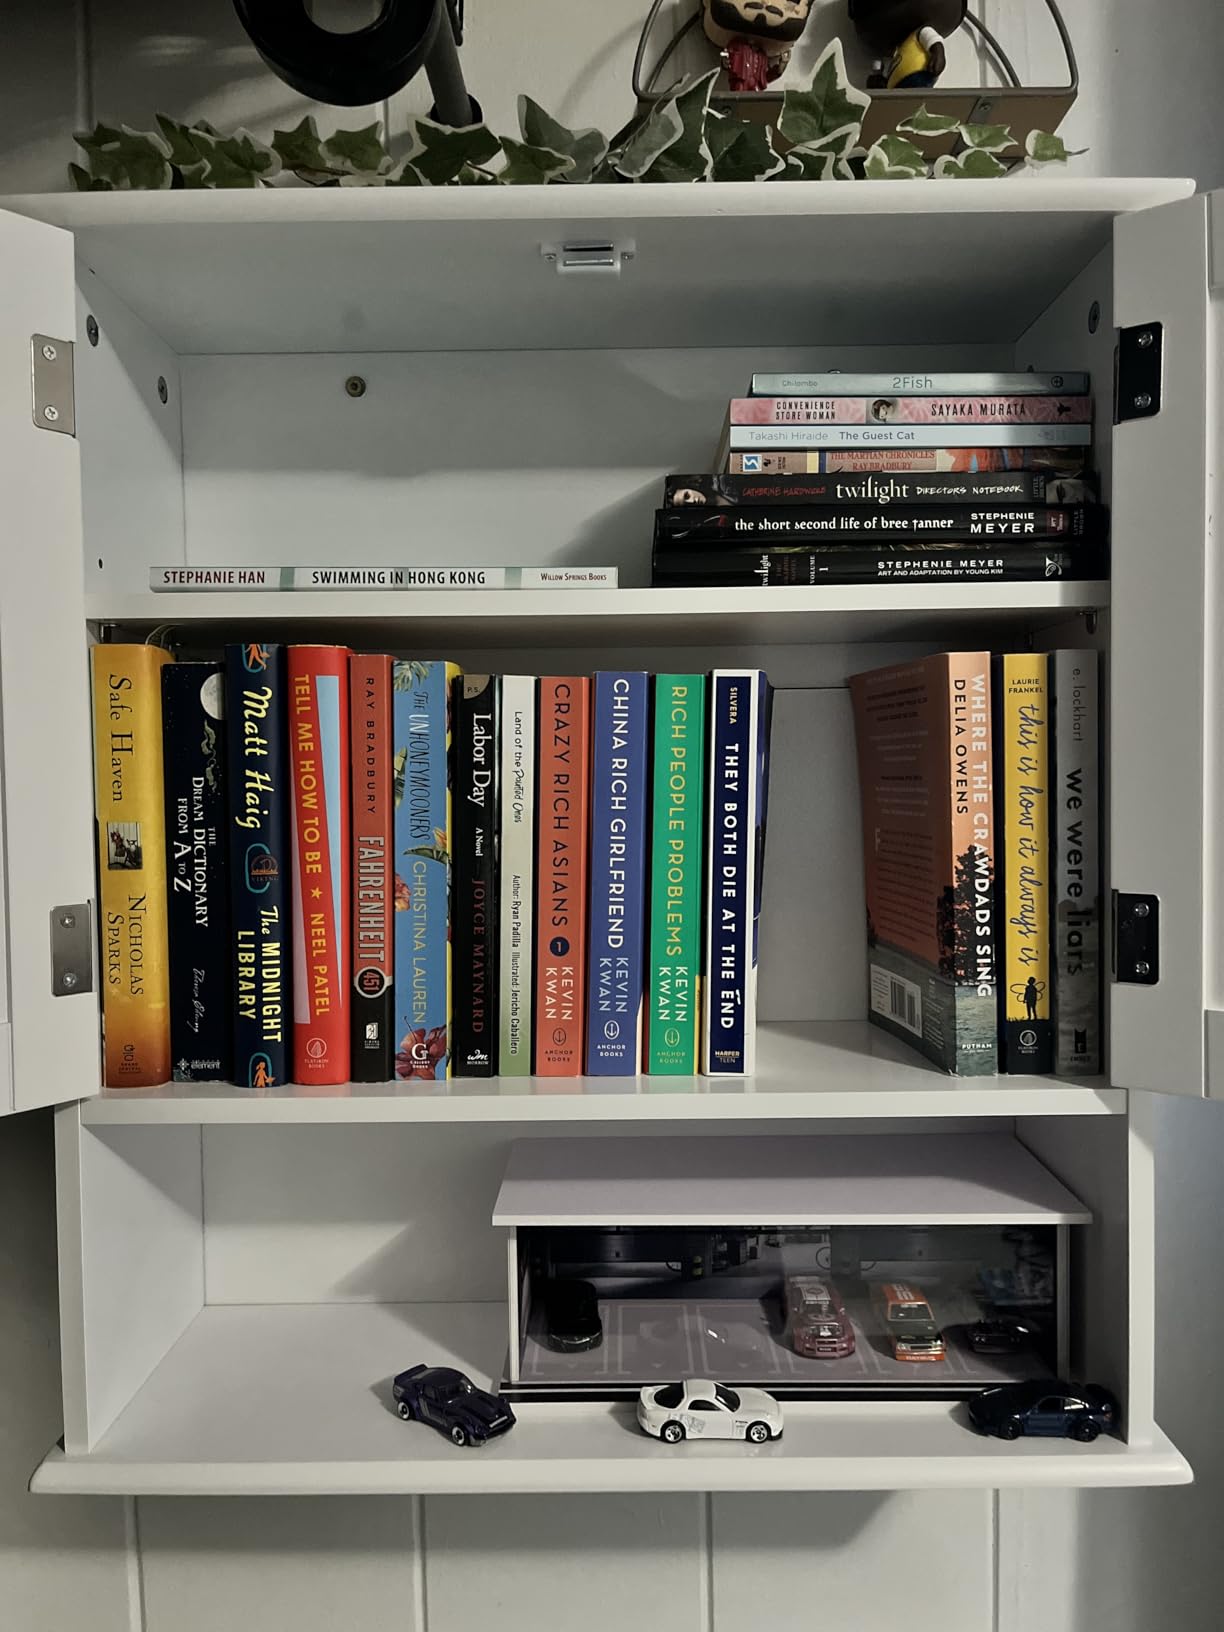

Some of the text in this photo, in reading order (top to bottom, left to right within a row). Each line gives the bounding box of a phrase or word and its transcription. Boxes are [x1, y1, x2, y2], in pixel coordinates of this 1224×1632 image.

[776, 401, 835, 410] CONVENIENCE
[892, 376, 933, 389] 2Fish
[931, 403, 1026, 416] SAYAKA MURATA
[749, 431, 829, 441] Takashi Hiraide
[775, 411, 836, 420] STORE WOMAN
[839, 431, 915, 441] The Guest Cat
[831, 450, 934, 460] THE MARTIAN CHRONICLES
[852, 461, 913, 471] RAY BRADBURY
[836, 475, 909, 504] twilight
[970, 512, 1035, 520] STEPHENIE
[973, 484, 1024, 495] NOTEBOOK
[735, 516, 954, 532] the short second life of bree tanner
[970, 523, 1035, 534] MEYER
[163, 571, 265, 584] STEPHANIE HAN
[312, 571, 486, 584] SWIMMING IN HONG KONG
[754, 555, 771, 586] twilight
[878, 559, 1004, 569] STEPHENIE MEYER
[966, 568, 990, 576] YOUNG
[729, 687, 738, 724] SILVERA
[1012, 678, 1040, 686] LAURIE
[108, 674, 133, 803] Safe Haven
[1073, 686, 1086, 742] lockhart
[235, 686, 275, 829] Matt Haig
[366, 677, 376, 814] RAY BRADBURY
[467, 713, 492, 808] Labor Day
[512, 711, 524, 823] Land of the Ones
[954, 679, 968, 814] DELIA OWENS
[294, 674, 322, 873] TELL ME HOW TO BE
[408, 714, 431, 841] UNHONEYMOONERS
[178, 798, 188, 834] FROM
[552, 684, 571, 926] CRAZY RICH ASIANS
[608, 679, 630, 948] CHINA RICH GIRLFRIEND
[666, 686, 688, 956] RICH PEOPLE PROBLEMS
[174, 841, 192, 860] A
[193, 777, 209, 927] DREAM DICTIONARY
[208, 827, 216, 846] THE
[475, 835, 484, 857] Novel
[971, 674, 992, 997] WHERE THE CRAWDADS SING
[1010, 704, 1044, 966] this is how it always is
[174, 877, 192, 892] Z
[358, 836, 384, 961] FAHRENHEIT
[721, 743, 739, 1028] THEY BOTH DIE AT THE END
[1066, 768, 1092, 976] we were liars
[512, 874, 521, 948] Author: Ryan Padilla
[107, 912, 124, 985] SPARKS
[128, 894, 147, 995] NICHOLAS
[310, 913, 330, 1016] NEEL PATEL
[412, 861, 427, 1024] CHRISTINA LAUREN
[472, 878, 485, 1033] JOYCE MAYNARD
[237, 931, 256, 1019] LIBRARY
[260, 905, 281, 1042] The MIDNIGHT
[363, 971, 380, 991] 451
[545, 967, 557, 1019] KWAN
[562, 966, 574, 1020] KEVIN
[599, 958, 612, 1012] KWAN
[616, 957, 629, 1013] KEVIN
[658, 967, 671, 1021] KWAN
[675, 966, 688, 1022] KEVIN
[511, 952, 520, 1055] Illustrated: Jericho Caballero
